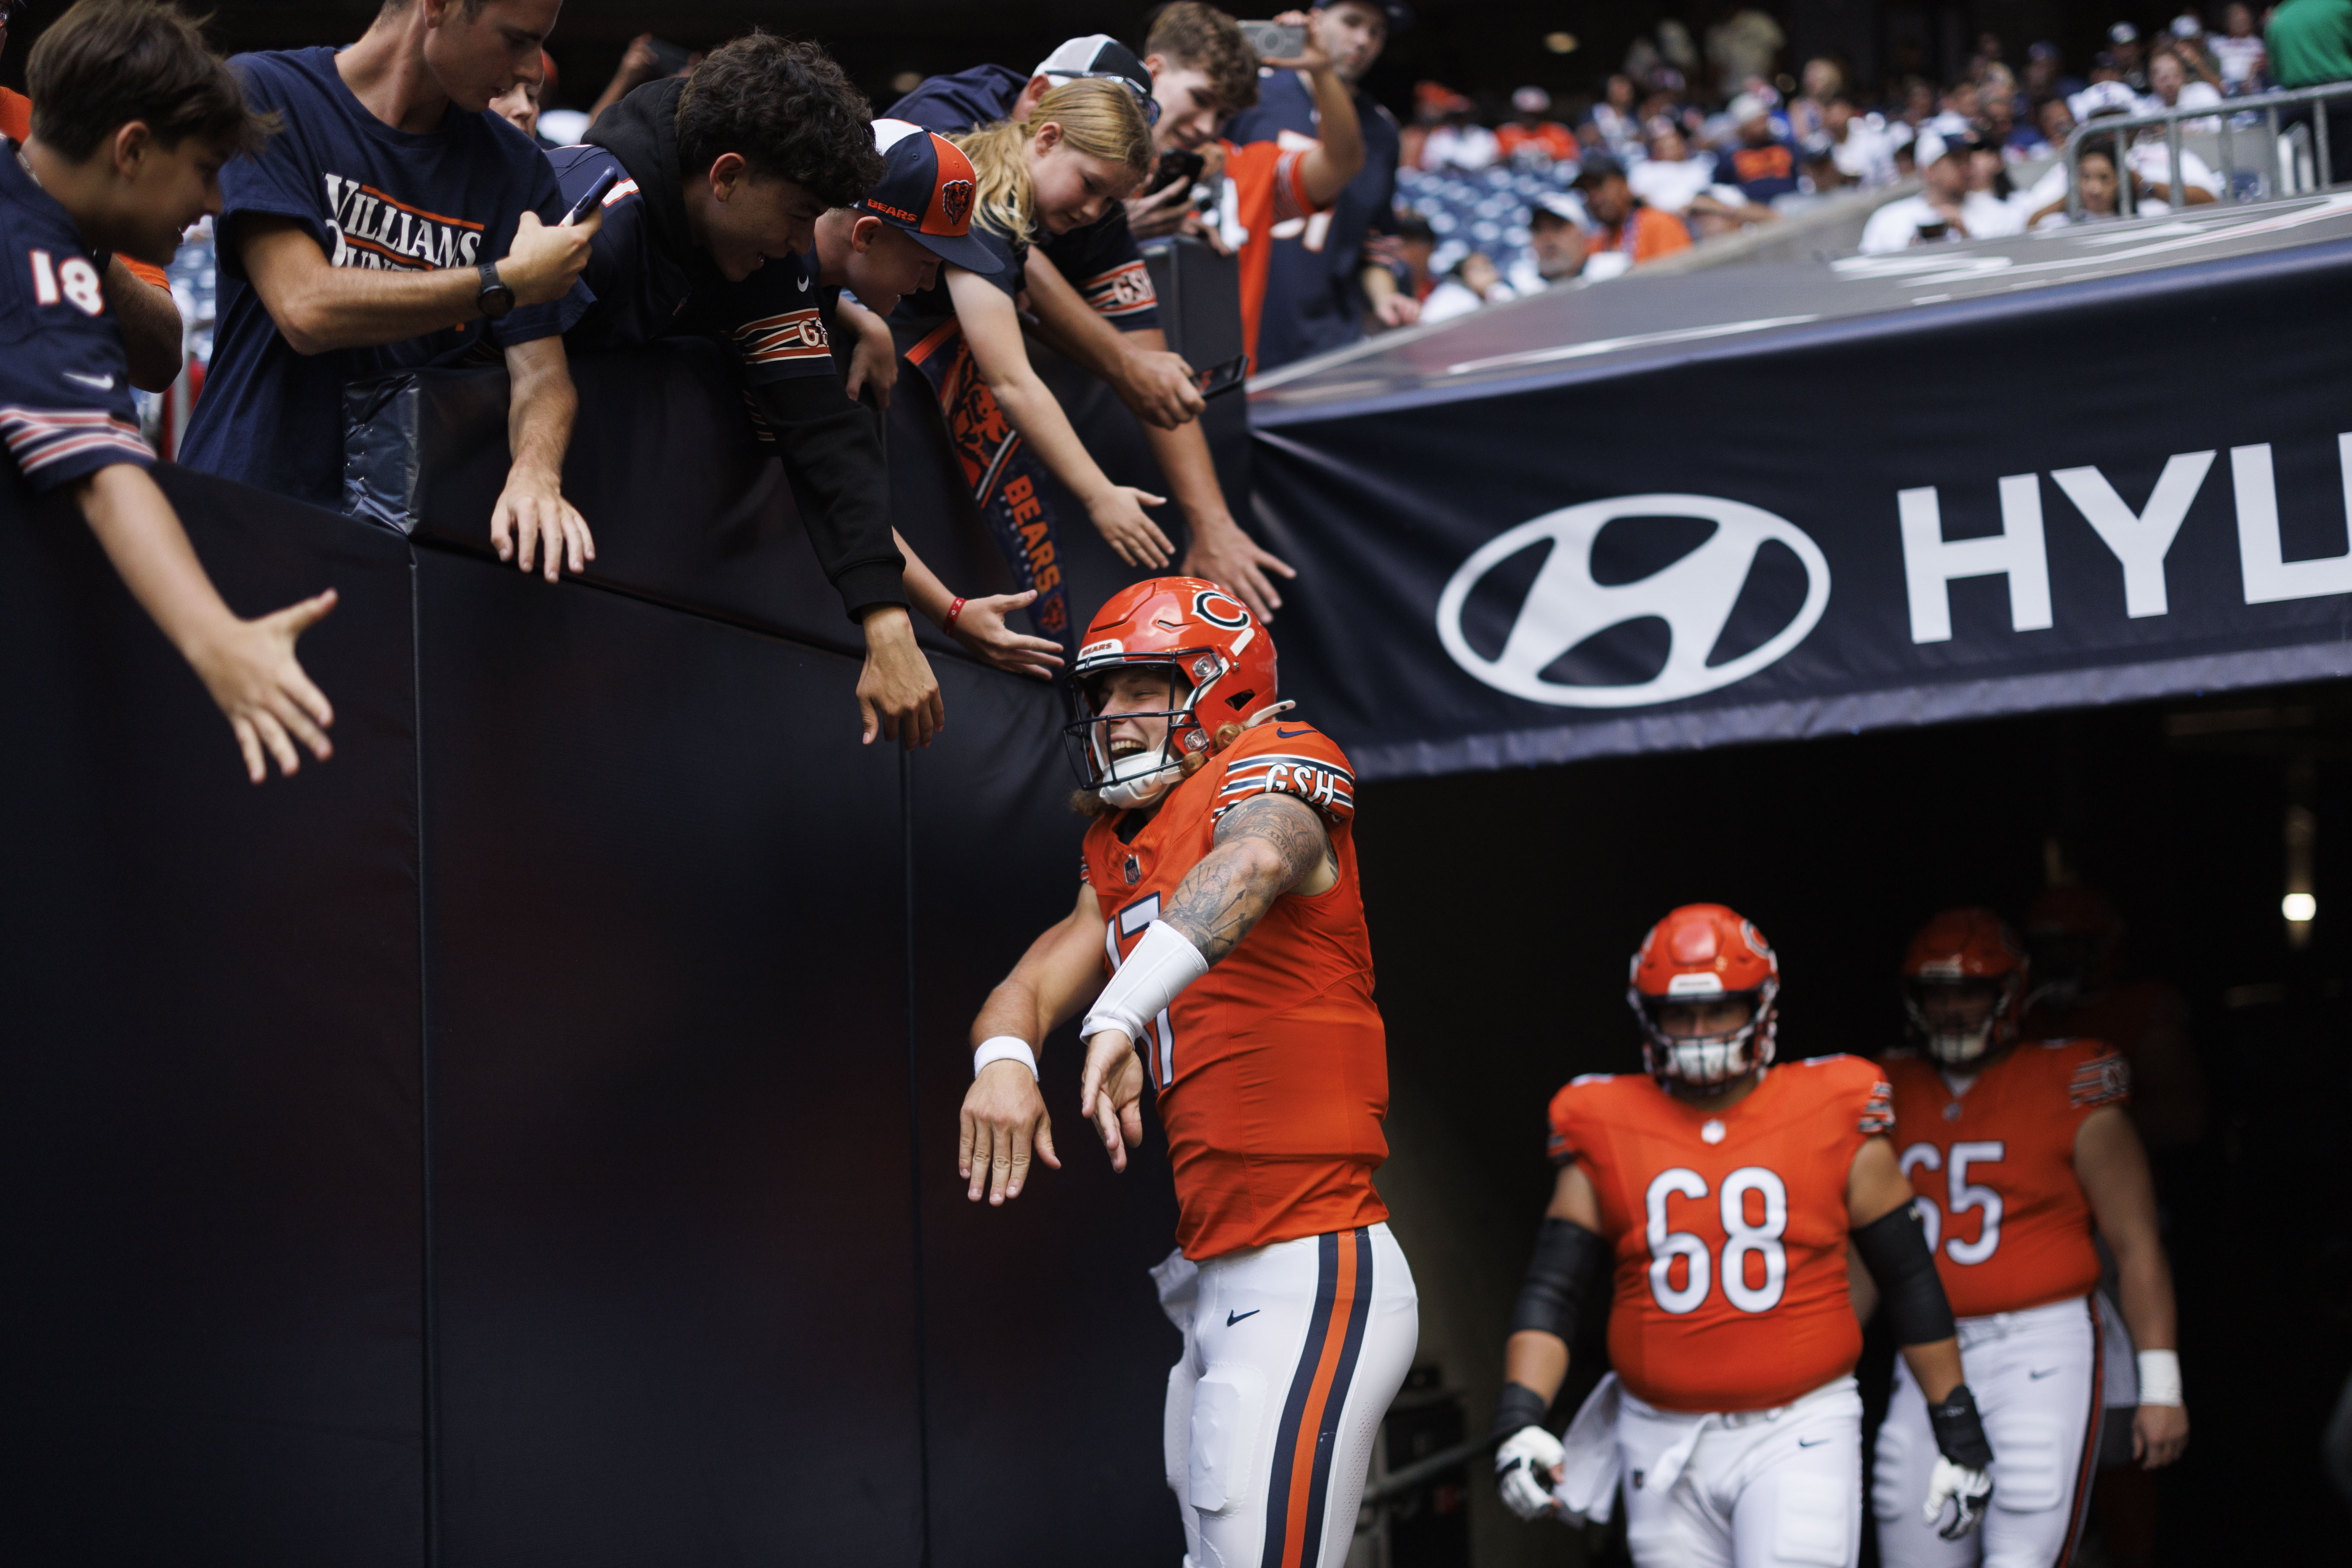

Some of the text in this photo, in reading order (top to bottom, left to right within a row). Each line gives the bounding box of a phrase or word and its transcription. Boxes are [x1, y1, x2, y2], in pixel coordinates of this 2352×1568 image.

[868, 198, 917, 222] BEARS
[29, 248, 105, 317] 18
[1003, 474, 1060, 595] BEARS
[1082, 642, 1112, 657] BEARS
[1264, 763, 1335, 808] GSH
[1646, 1166, 1788, 1314] 68
